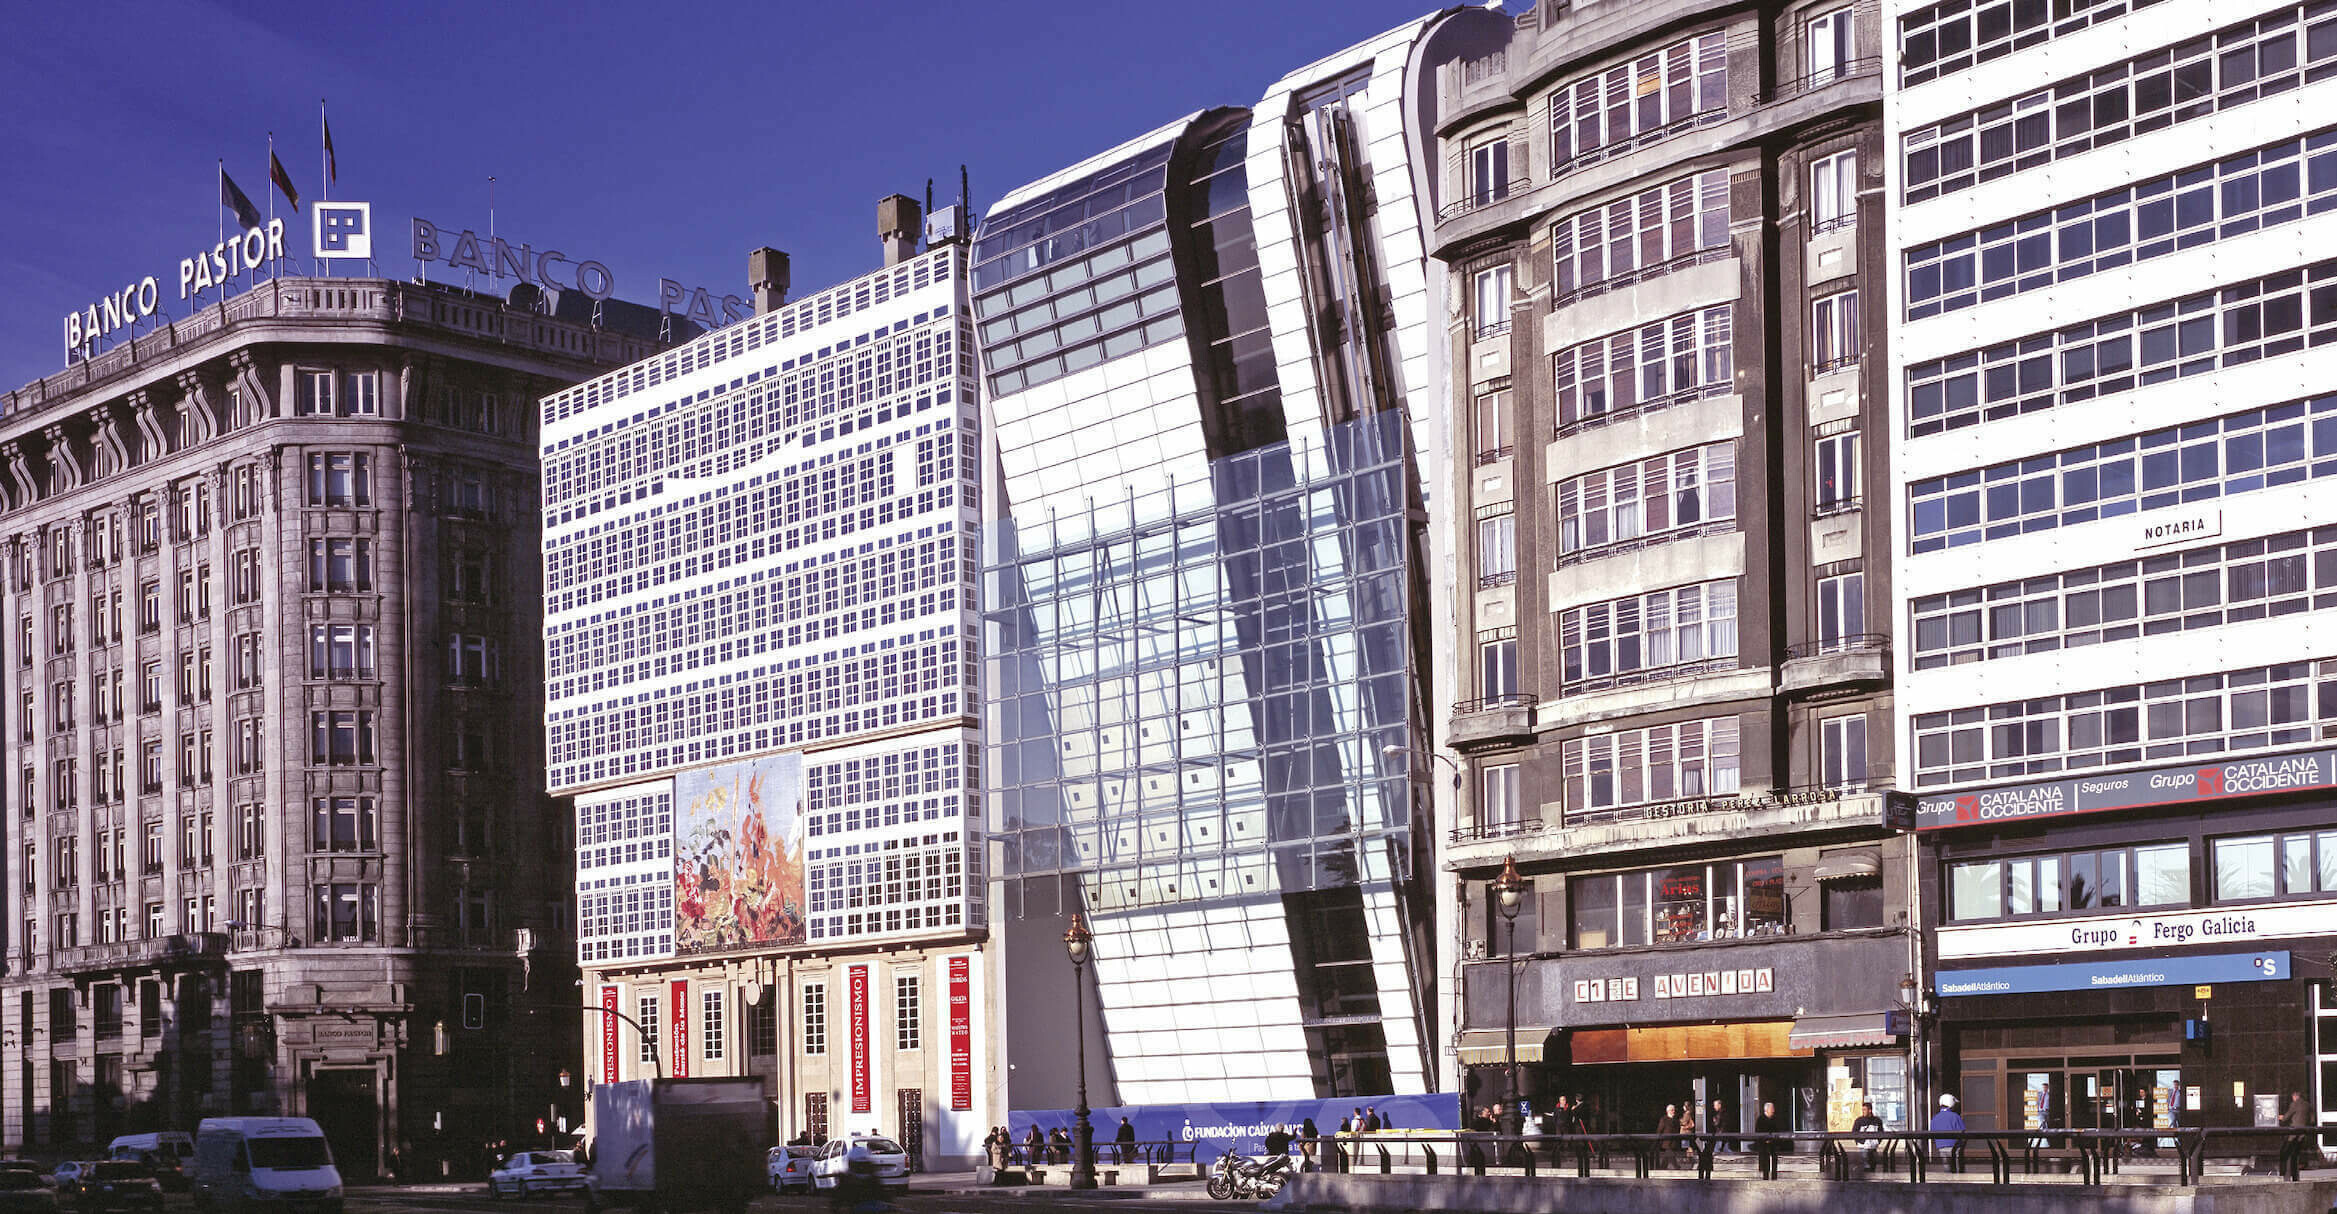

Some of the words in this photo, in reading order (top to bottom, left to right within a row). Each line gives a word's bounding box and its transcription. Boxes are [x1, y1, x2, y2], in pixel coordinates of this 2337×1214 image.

[68, 276, 159, 349] BANCO
[180, 217, 285, 299] PASTOR
[412, 217, 614, 301] BANCO
[660, 278, 755, 328] PAS
[2145, 518, 2204, 540] NOTARIA
[2081, 779, 2129, 793] Seguros
[2150, 773, 2195, 789] Grupo
[2224, 757, 2319, 780] CATALANA
[2224, 770, 2320, 793] OCCIDENTE
[1646, 800, 1708, 818] GESTORIA
[1722, 797, 1762, 810] PEREZ
[1774, 789, 1836, 805] LARROSA
[1916, 799, 1956, 817] Grupo
[1980, 786, 2064, 806] CATALANA
[1980, 799, 2064, 820] OCCIDENTE
[1660, 882, 1700, 897] Arias
[2071, 928, 2117, 946] Grupo
[2154, 922, 2194, 942] Fergo
[2202, 916, 2256, 936] Galicia
[1656, 971, 1771, 996] AVENIDA
[1942, 980, 2010, 994] SabadellAtlántico
[2091, 972, 2165, 986] SabadellAtlántico
[605, 999, 614, 1086] PRESIONISMO
[854, 978, 864, 1096] IMPRESIONISMO
